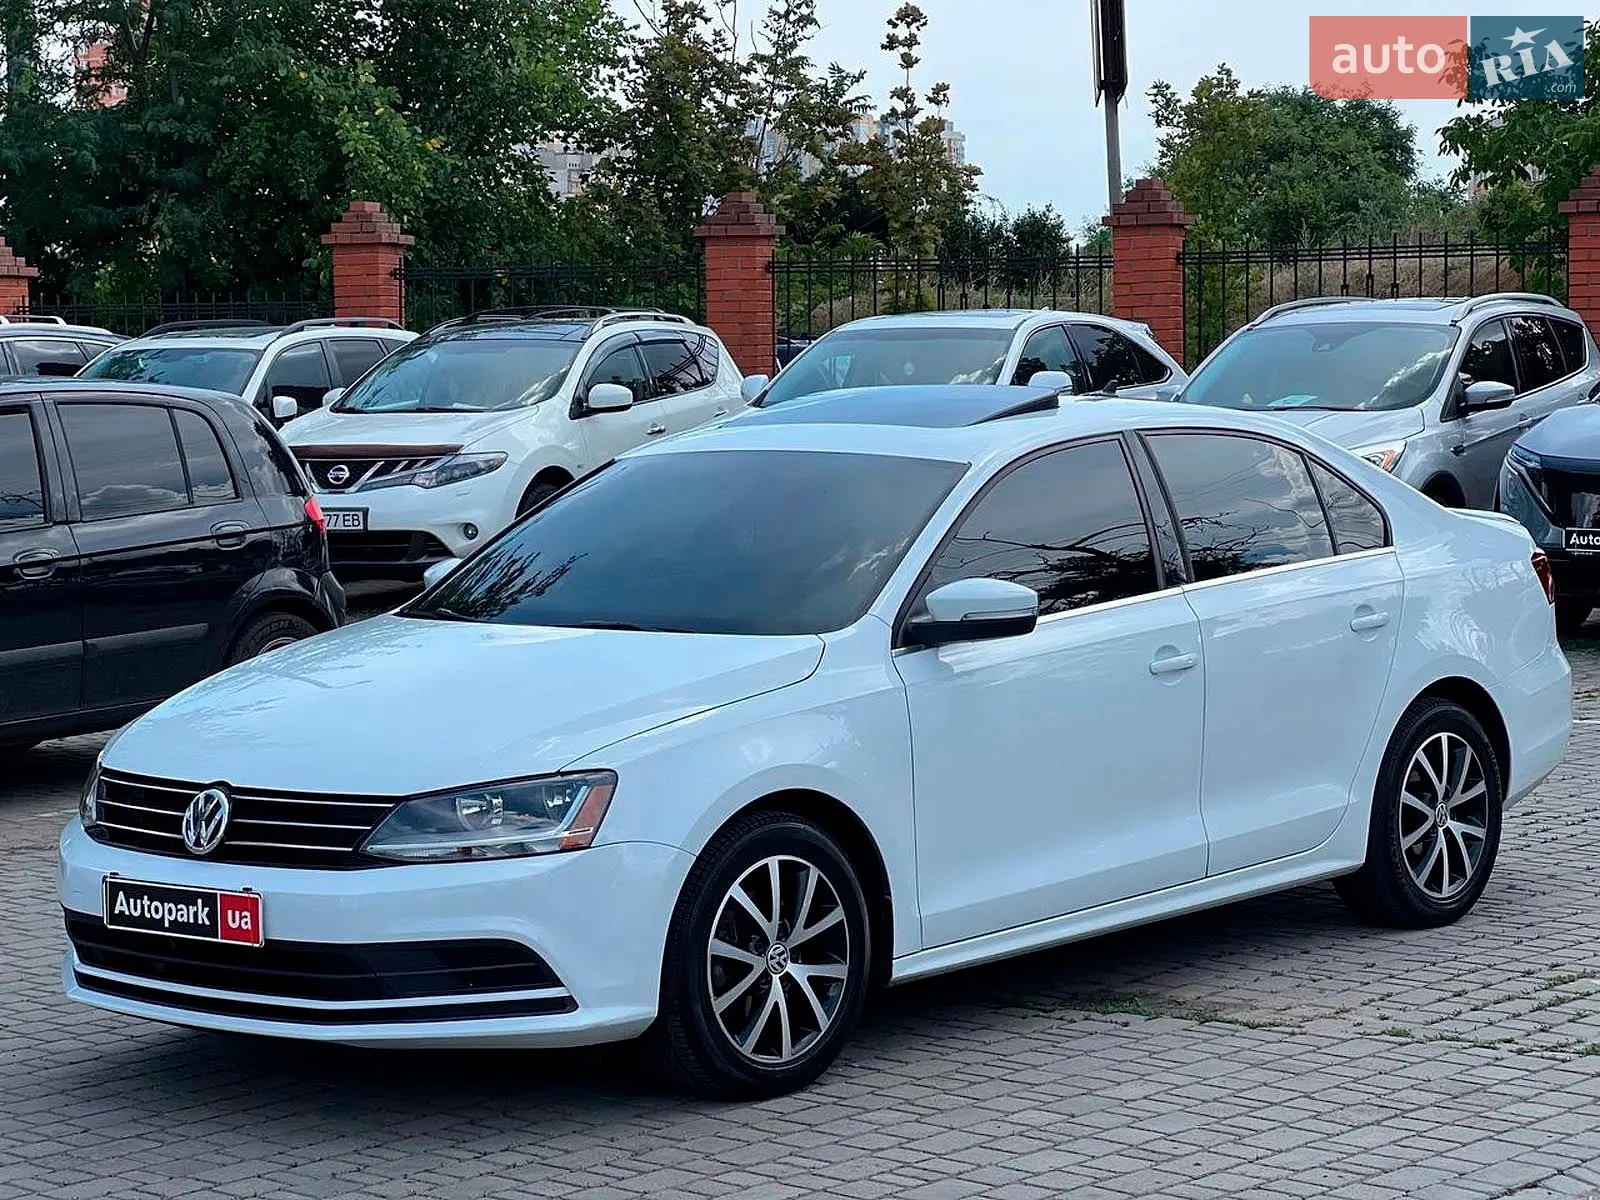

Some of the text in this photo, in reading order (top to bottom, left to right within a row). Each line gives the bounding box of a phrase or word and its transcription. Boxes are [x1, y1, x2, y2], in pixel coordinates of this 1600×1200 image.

[342, 513, 361, 527] EB
[114, 890, 252, 931] Autopark ua
